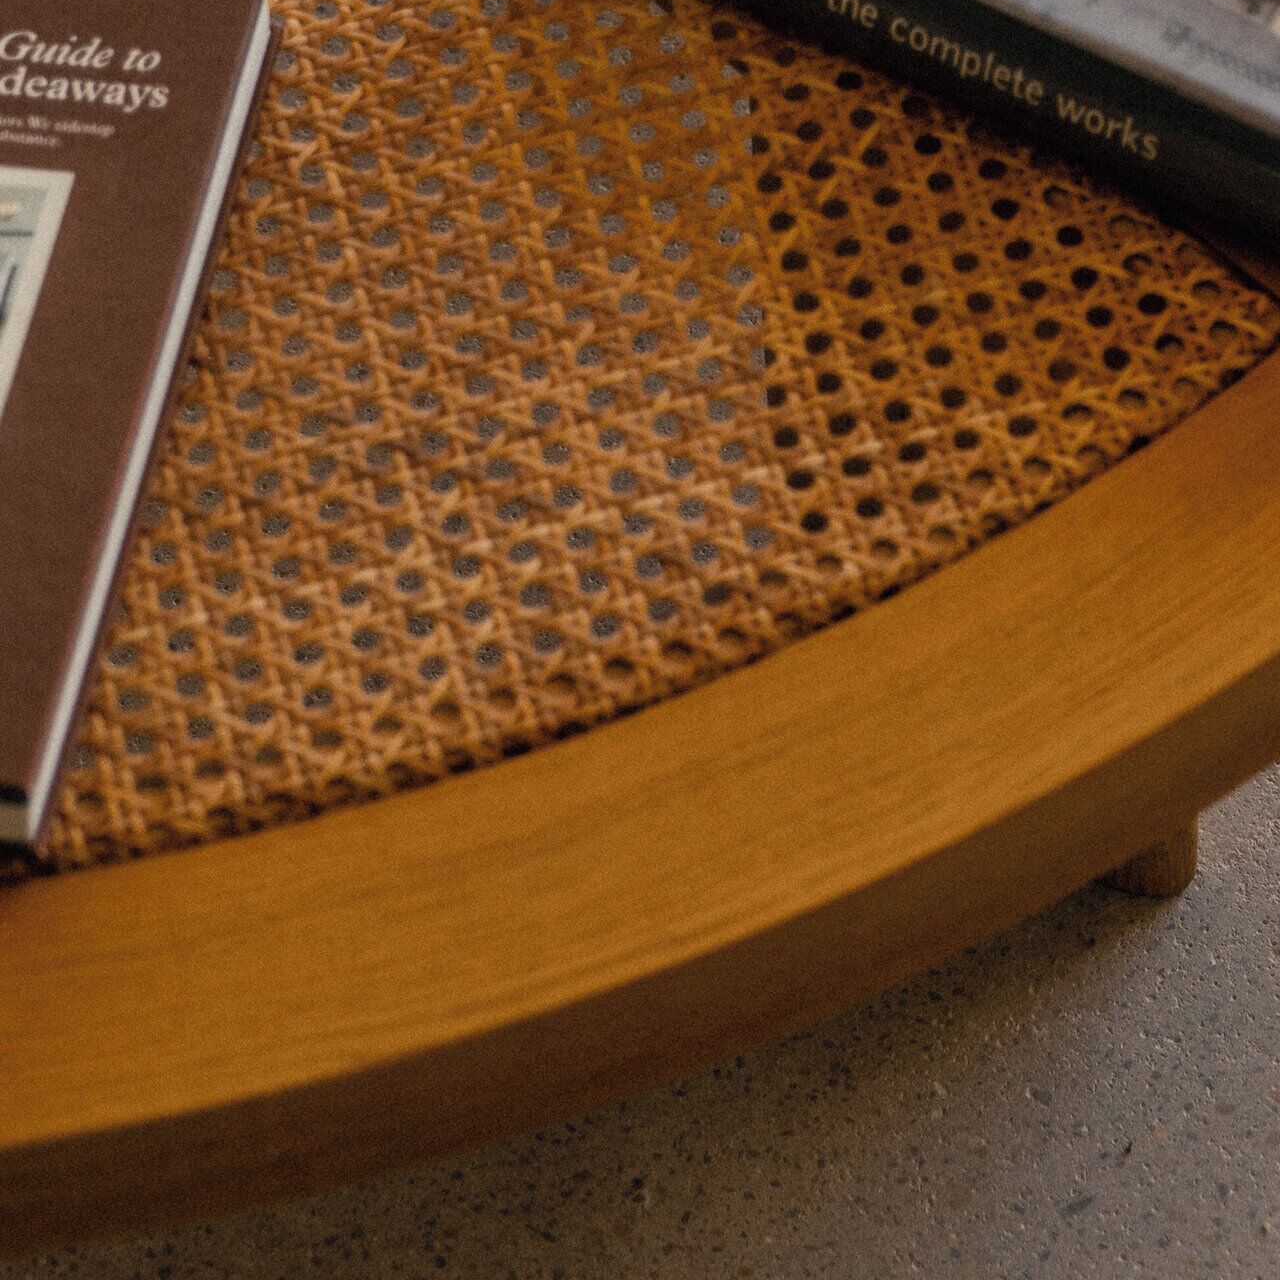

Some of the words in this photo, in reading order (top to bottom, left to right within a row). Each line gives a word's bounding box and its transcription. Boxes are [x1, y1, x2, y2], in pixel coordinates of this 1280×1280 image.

[0, 28, 115, 68] Guide
[122, 47, 162, 72] to
[0, 65, 170, 113] deaways
[889, 15, 1045, 107] complete
[1055, 92, 1159, 161] works
